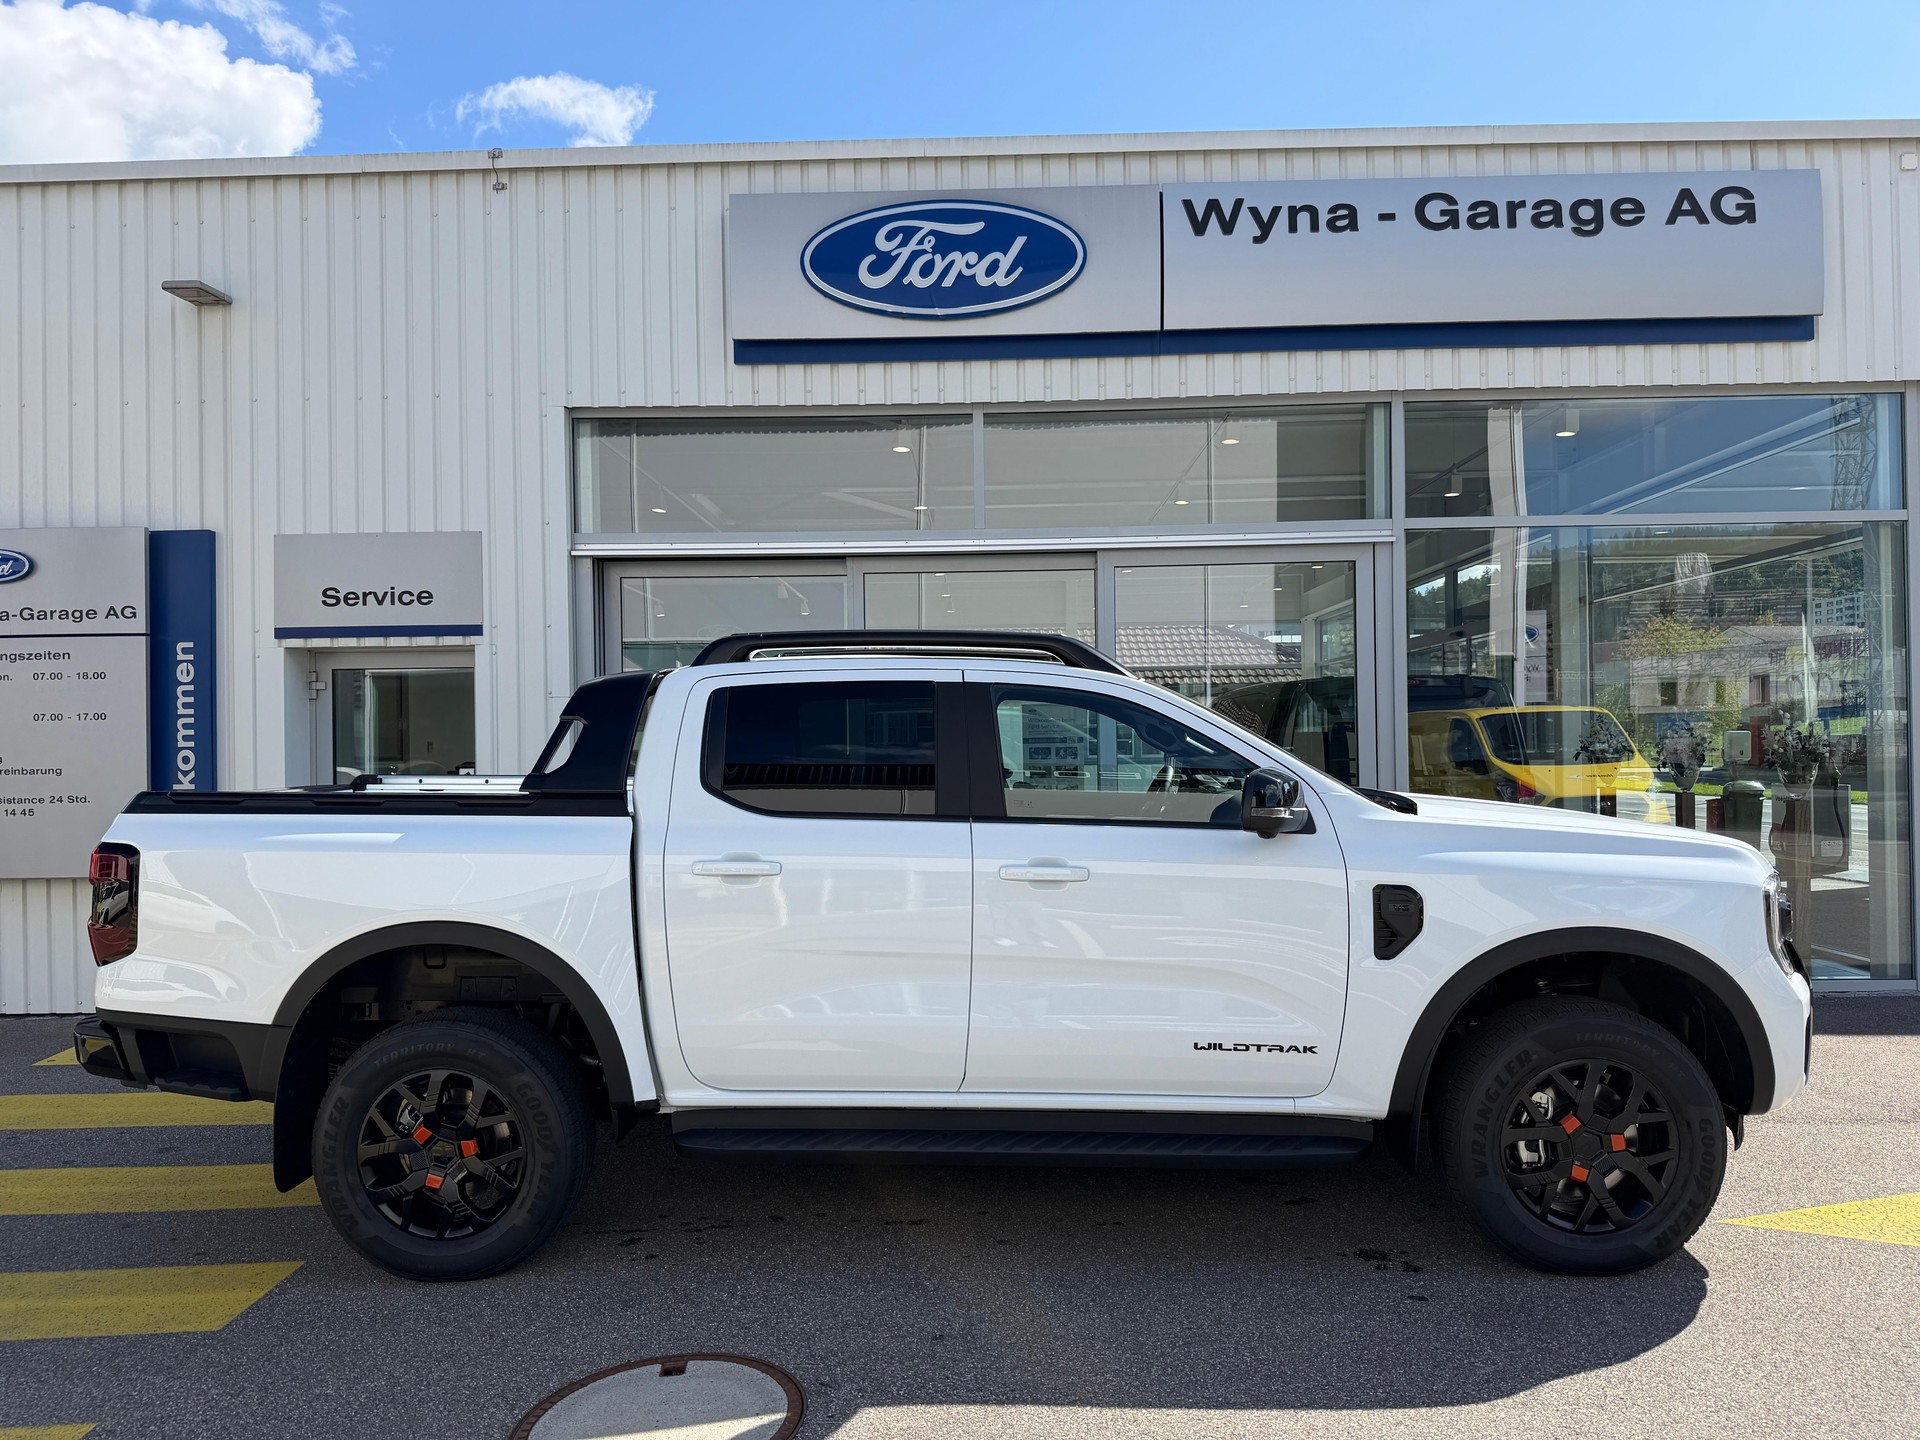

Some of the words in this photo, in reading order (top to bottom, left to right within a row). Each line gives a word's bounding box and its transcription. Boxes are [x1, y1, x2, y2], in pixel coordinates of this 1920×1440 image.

[1181, 197, 1360, 245] Wyna
[1414, 191, 1646, 237] Garage
[1664, 185, 1757, 225] AG
[858, 219, 1028, 289] Ford
[320, 586, 434, 607] Service
[104, 605, 137, 619] AG
[32, 672, 63, 681] 07.00
[76, 671, 107, 680] 18.00
[33, 713, 63, 722] 07.00
[76, 712, 107, 721] 17.00
[172, 641, 196, 791] kommen
[49, 795, 64, 804] 24
[67, 795, 91, 804] Std.
[4, 808, 17, 817] 14
[20, 808, 35, 817] 45
[374, 1042, 455, 1068] TERRITORY
[1193, 1042, 1319, 1055] WILDTRAK
[1575, 1032, 1660, 1058] TERRITORY
[1471, 1047, 1536, 1179] WRANGLER
[322, 1096, 359, 1232] WRANGLER
